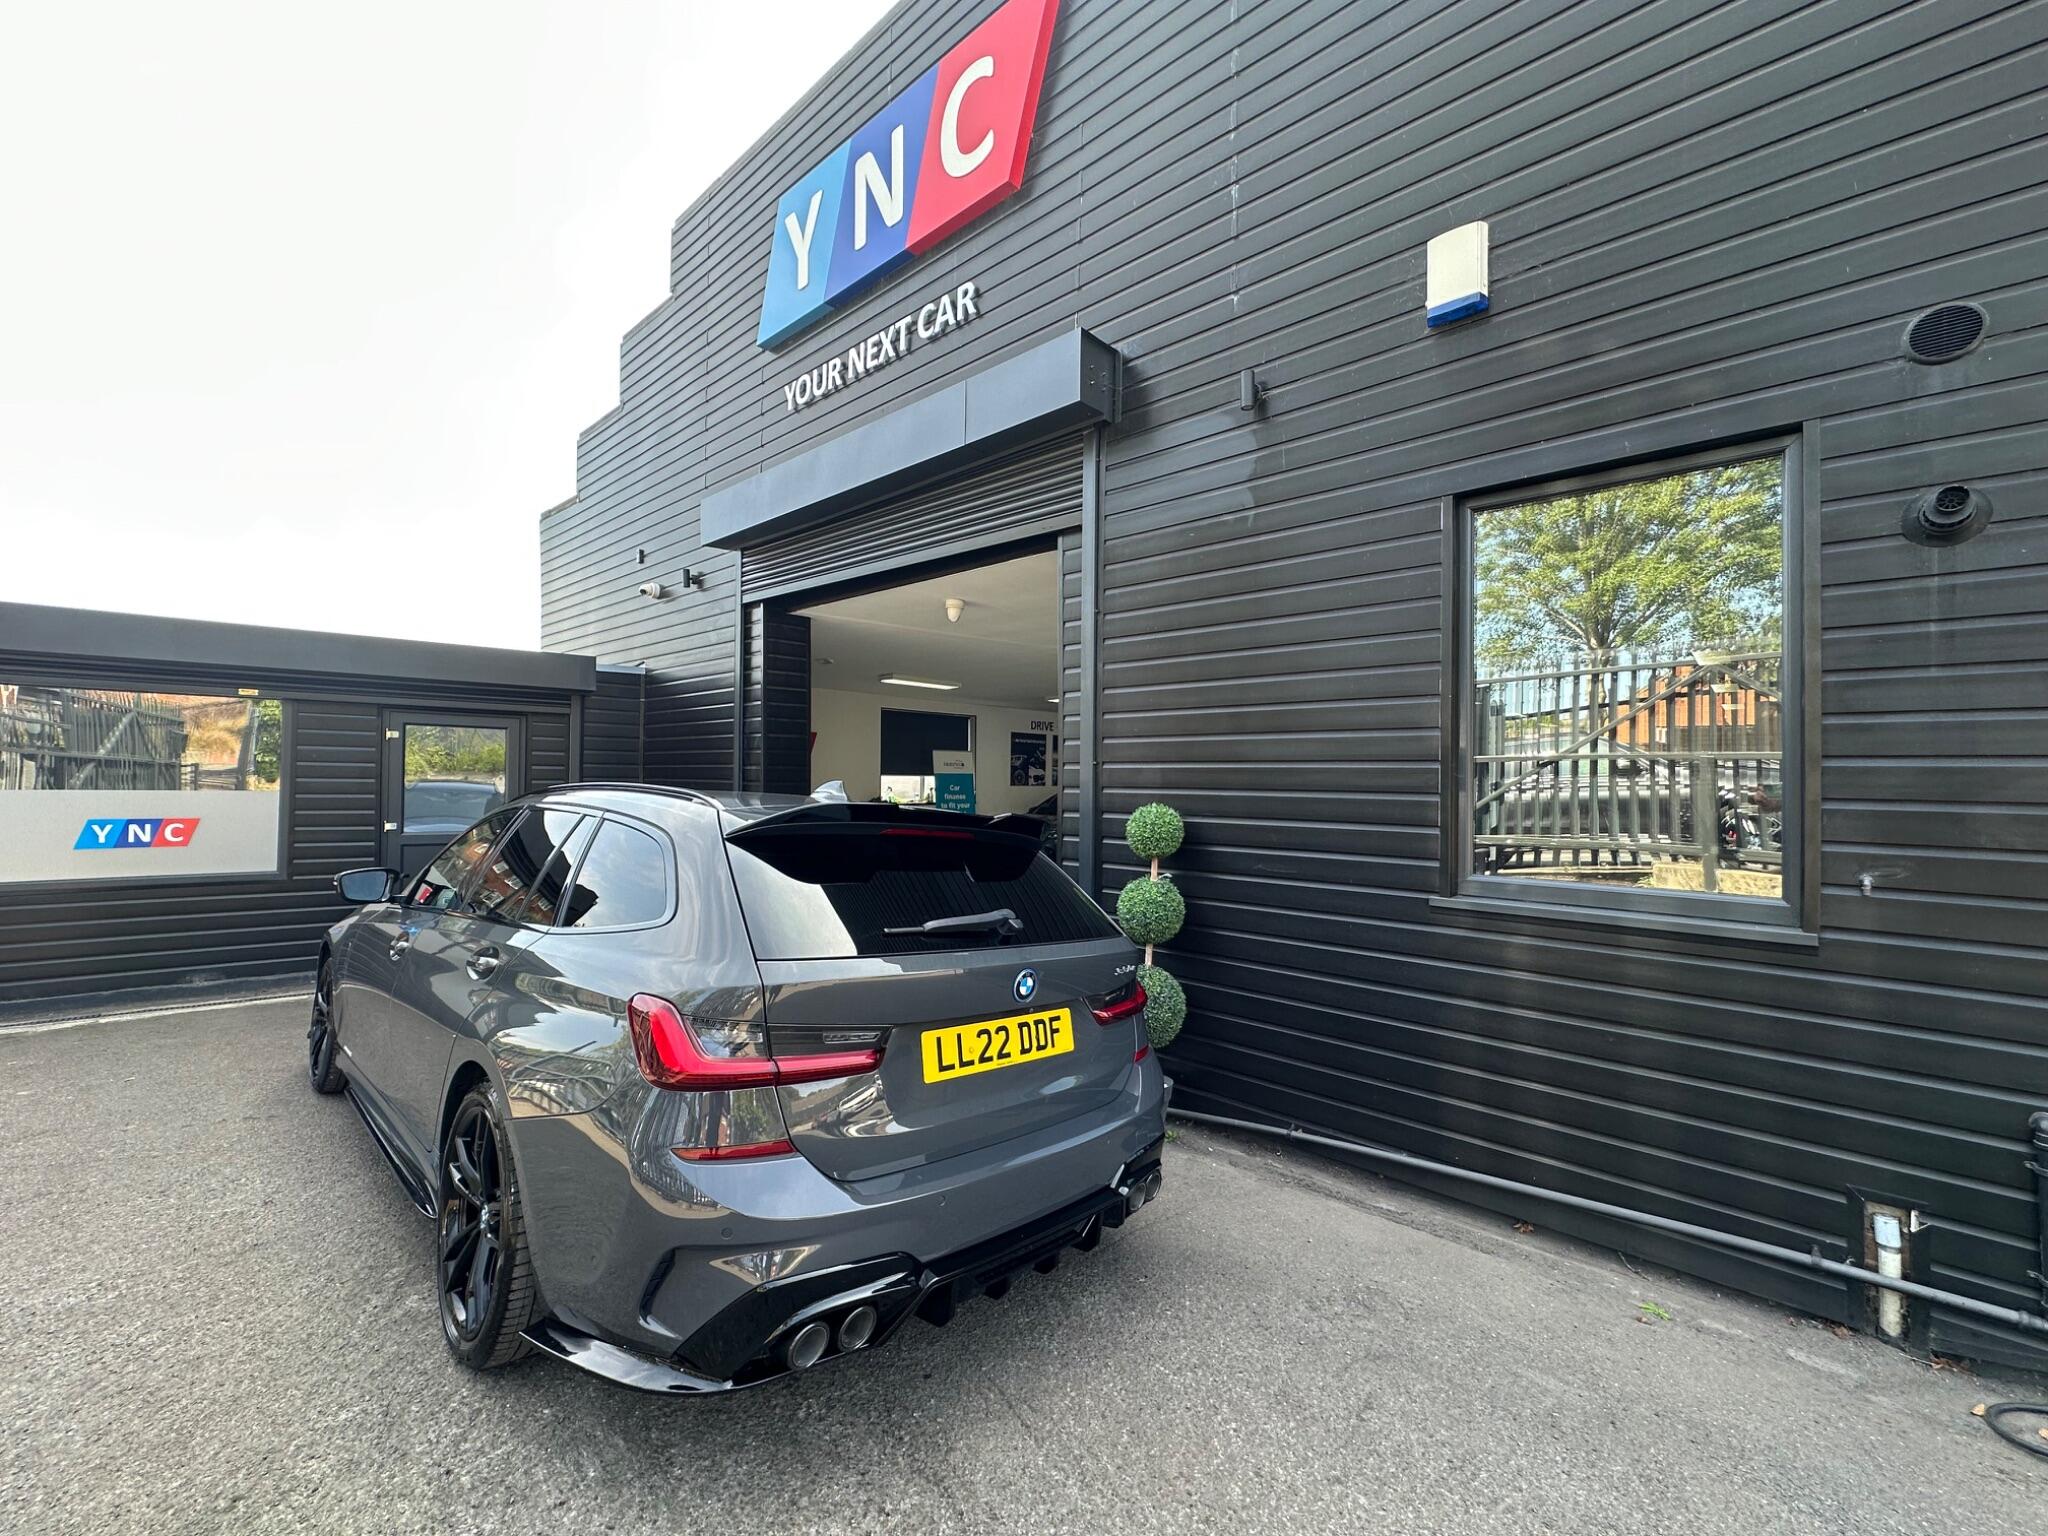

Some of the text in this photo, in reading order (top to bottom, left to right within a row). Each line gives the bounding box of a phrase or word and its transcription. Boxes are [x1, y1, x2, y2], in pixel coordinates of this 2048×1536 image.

[784, 55, 995, 290] YNC
[784, 281, 977, 411] YOUR NEXT CAR
[1030, 720, 1055, 732] DRIVE
[949, 784, 961, 792] Car
[91, 823, 185, 843] YNC
[936, 1015, 1061, 1073] LL22 DDF
